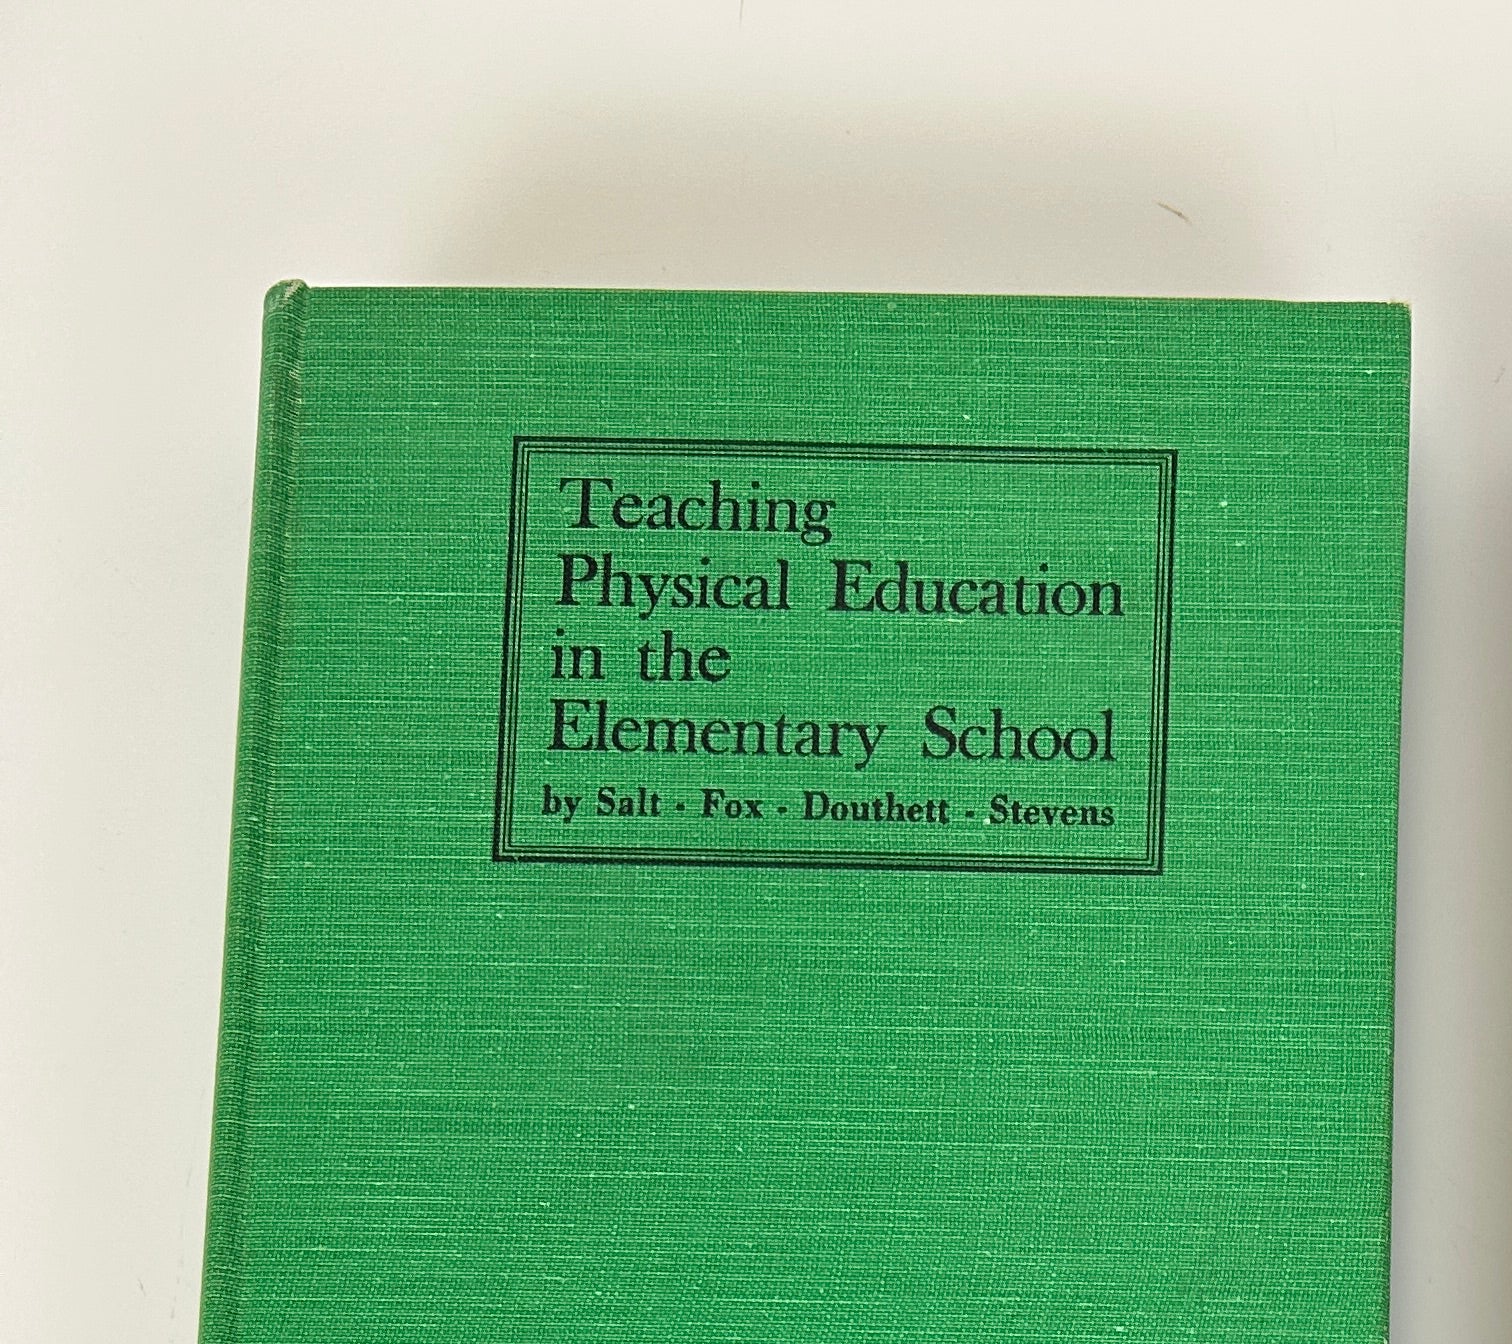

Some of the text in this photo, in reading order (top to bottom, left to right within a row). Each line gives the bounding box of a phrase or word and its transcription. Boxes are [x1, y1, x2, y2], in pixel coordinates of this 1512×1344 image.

[559, 477, 835, 546] Teaching
[556, 552, 1124, 621] Physical Education
[552, 628, 731, 683] in the
[547, 698, 1115, 770] Elementary School
[542, 785, 1115, 828] by Salt Fox Douthett Stevens
